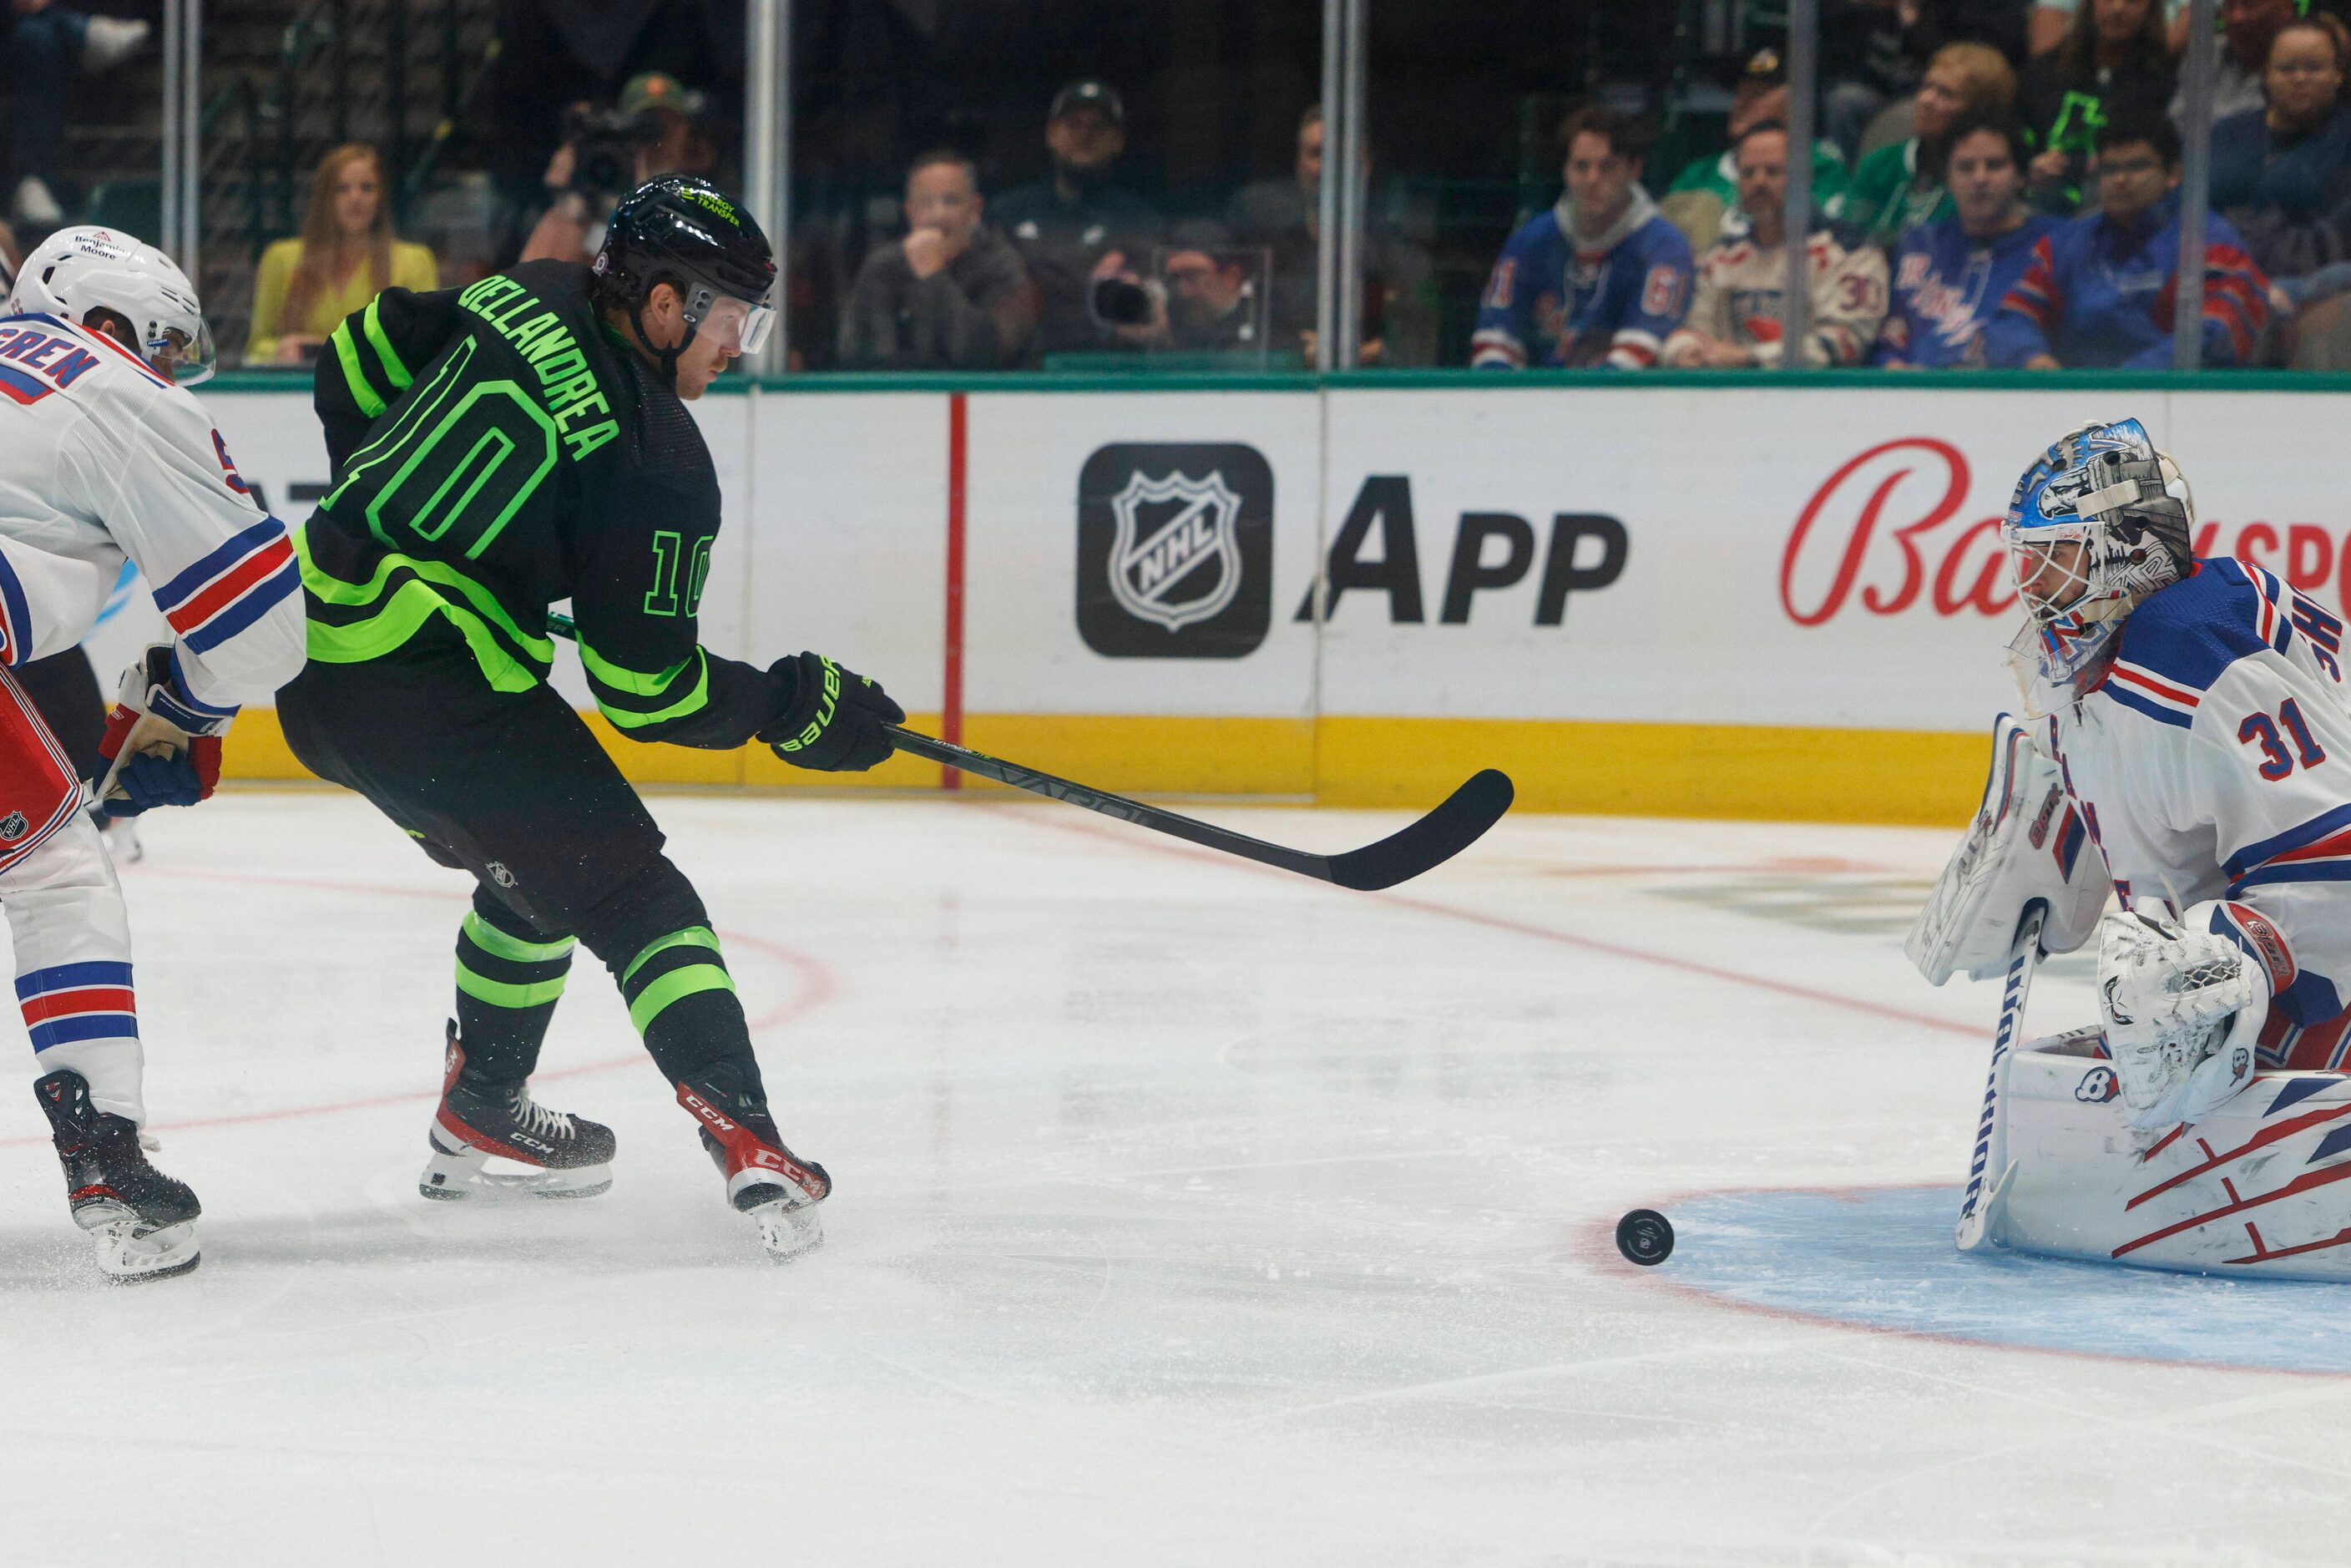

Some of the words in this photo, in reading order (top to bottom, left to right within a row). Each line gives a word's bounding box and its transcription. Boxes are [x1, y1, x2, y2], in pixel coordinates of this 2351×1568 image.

[698, 197, 741, 227] TRANSFER
[80, 245, 116, 260] Moore
[458, 275, 620, 463] DELLANDREA
[317, 334, 559, 560] 10
[644, 530, 715, 618] 10
[1140, 513, 1214, 590] NHL
[2235, 521, 2351, 629] SP
[779, 655, 841, 751] BAUER
[2237, 696, 2327, 782] 31
[6, 817, 19, 837] NHL
[510, 1131, 554, 1154] CCM
[685, 1094, 735, 1131] CCM
[755, 1148, 822, 1195] CCM
